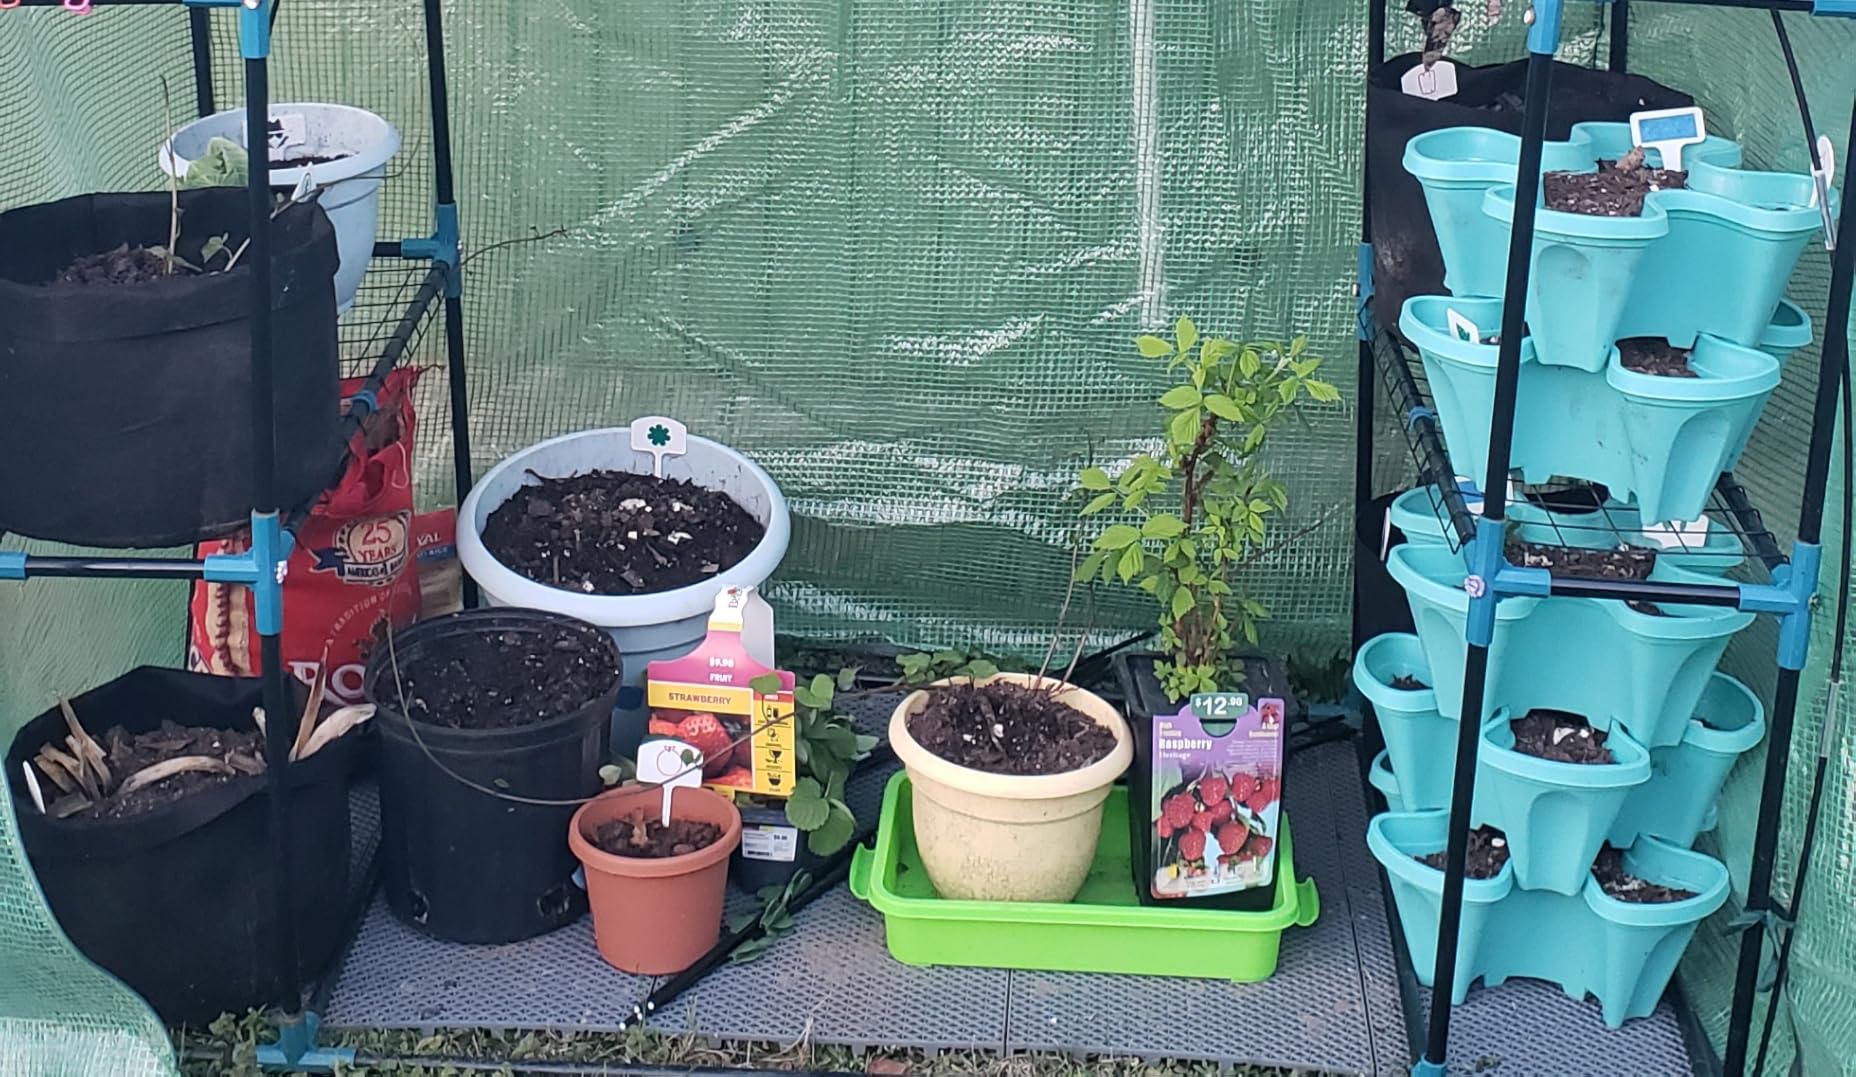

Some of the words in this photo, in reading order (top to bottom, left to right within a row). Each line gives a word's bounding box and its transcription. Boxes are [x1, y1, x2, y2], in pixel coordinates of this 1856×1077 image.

[361, 521, 392, 546] 25
[358, 546, 398, 562] YEARS
[329, 595, 378, 638] TRADITION
[708, 672, 733, 683] FRUIT
[668, 692, 732, 705] STRAWBERRY
[1158, 738, 1213, 751] Raspberry
